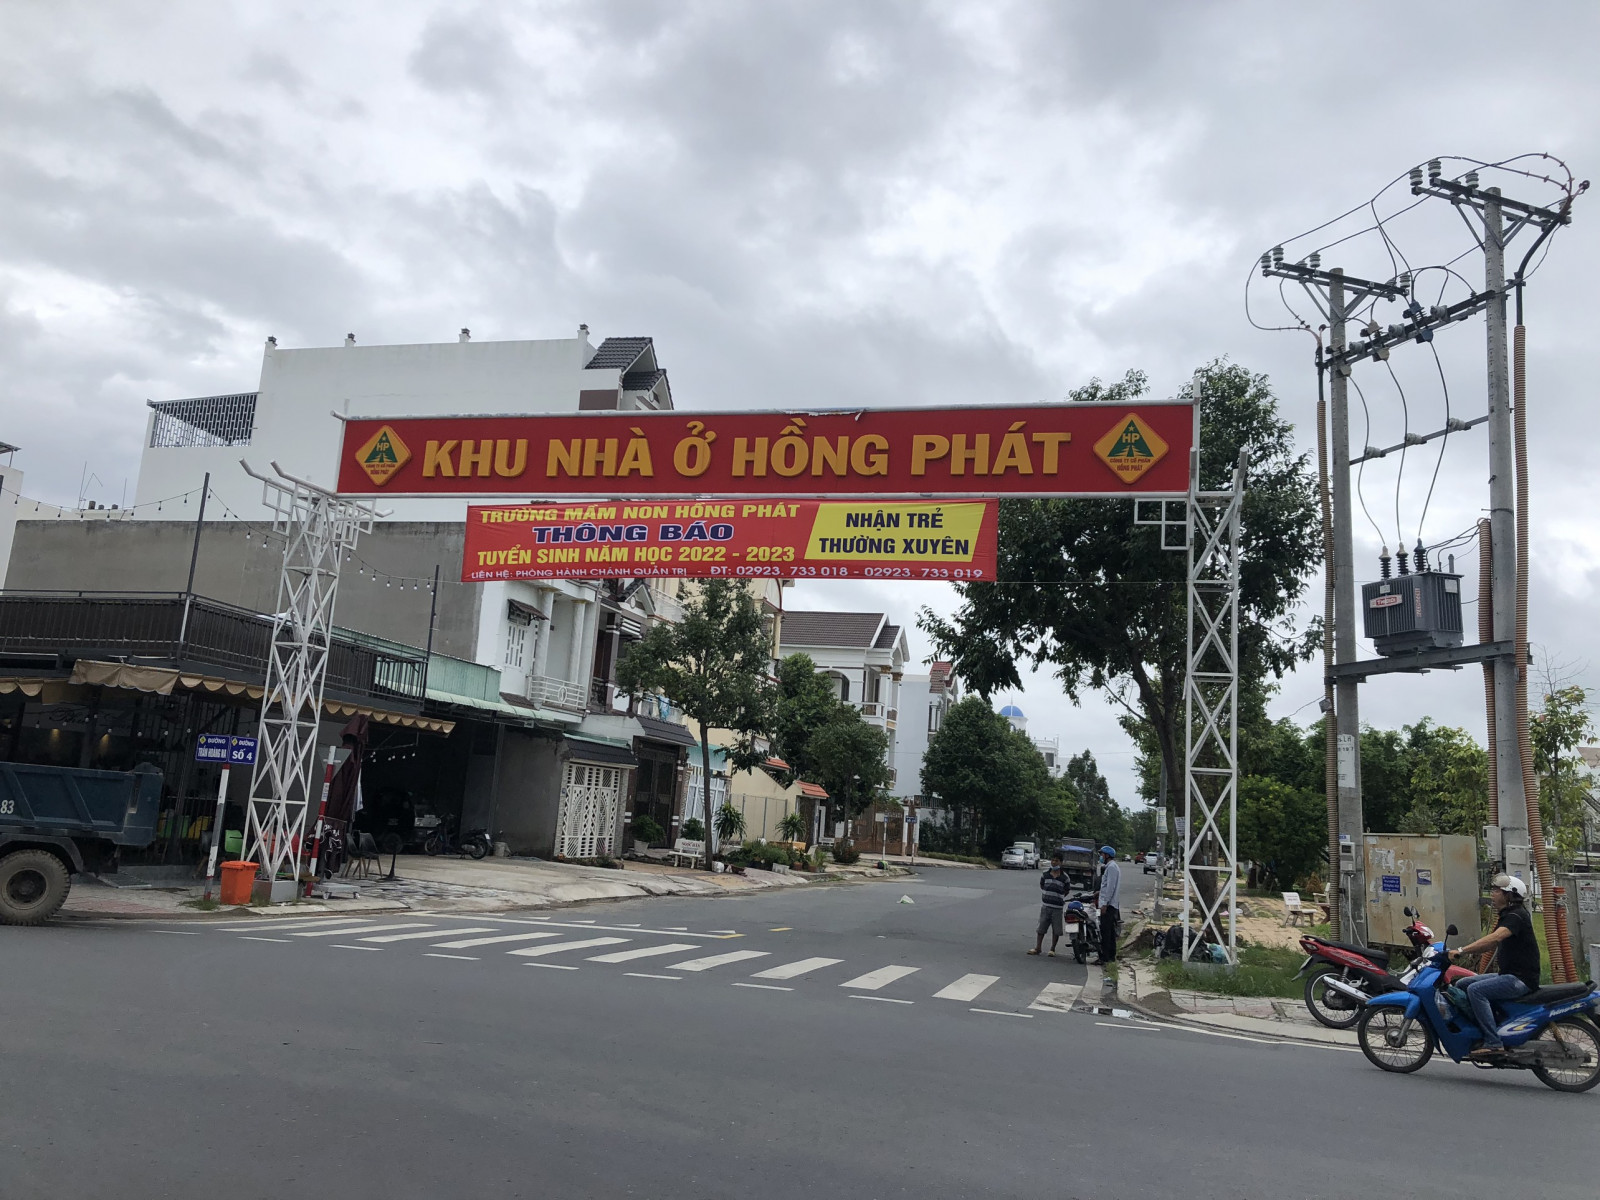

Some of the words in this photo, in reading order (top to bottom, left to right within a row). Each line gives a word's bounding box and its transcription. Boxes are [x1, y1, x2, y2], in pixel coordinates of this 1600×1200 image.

[423, 439, 528, 477] KHU
[546, 427, 654, 477] NHÀ
[674, 420, 717, 477] Ở
[732, 418, 890, 477] HỒNG
[911, 421, 1071, 475] PHÁT
[1121, 432, 1140, 444] HP
[480, 507, 559, 524] TRƯỜNG
[563, 504, 617, 521] MẦM
[622, 505, 669, 520] NON
[674, 502, 736, 519] HỒNG
[742, 501, 801, 518] PHÁT
[845, 509, 901, 532] NHẬN
[906, 507, 944, 529] TRẺ
[532, 522, 649, 544] THÔNG
[658, 520, 735, 542] BÁO
[477, 544, 532, 566] TUYỂN
[536, 547, 581, 564] SINH
[584, 545, 629, 563] NĂM
[634, 546, 673, 565] HỌC
[677, 546, 727, 562] 2022
[745, 546, 796, 562] 2023
[819, 534, 896, 554] THƯỜNG
[902, 535, 970, 556] XUYÊN
[471, 570, 494, 579] LIÊN
[495, 570, 513, 579] HỆ:
[516, 568, 553, 577] PHÒNG
[556, 567, 587, 576] HÀNH
[590, 567, 631, 576] CHÁNH
[634, 565, 669, 576] QUẢN
[671, 567, 687, 577] TRỊ
[710, 566, 732, 575] ĐT:
[736, 566, 785, 576] 02923.
[790, 566, 817, 576] 733
[820, 566, 849, 576] 018
[864, 567, 916, 578] 02923.
[921, 568, 949, 578] 733
[953, 568, 984, 579] 019
[232, 748, 246, 760] SỐ
[246, 752, 253, 761] 4
